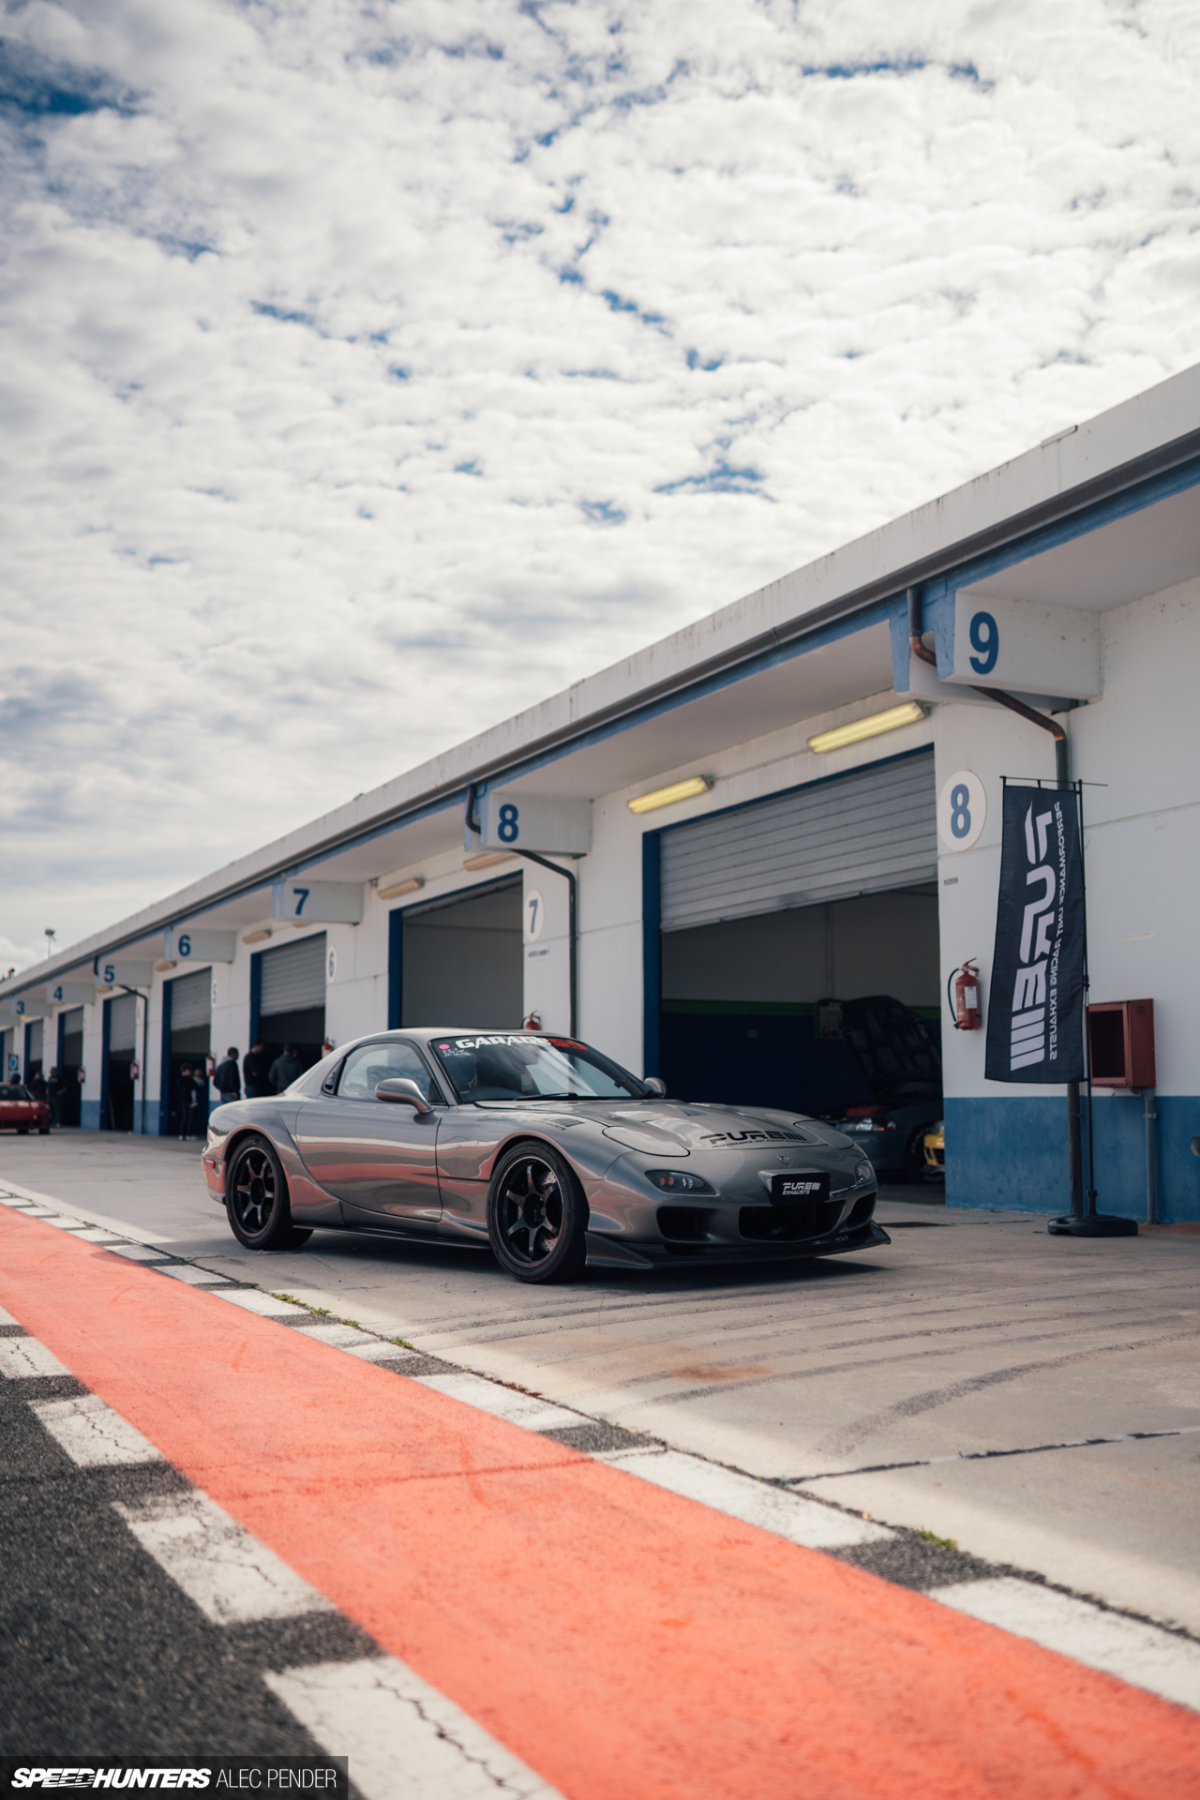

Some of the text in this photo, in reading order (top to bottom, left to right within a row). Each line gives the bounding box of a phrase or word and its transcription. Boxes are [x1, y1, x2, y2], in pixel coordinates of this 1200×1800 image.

[969, 611, 999, 675] 9
[497, 803, 519, 843] 8
[949, 783, 972, 839] 8
[293, 888, 310, 916] 7
[529, 898, 538, 934] 7
[178, 934, 191, 957] 6
[103, 965, 115, 983] 5
[328, 951, 335, 978] 6
[53, 985, 63, 1002] 4
[16, 1001, 25, 1015] 3
